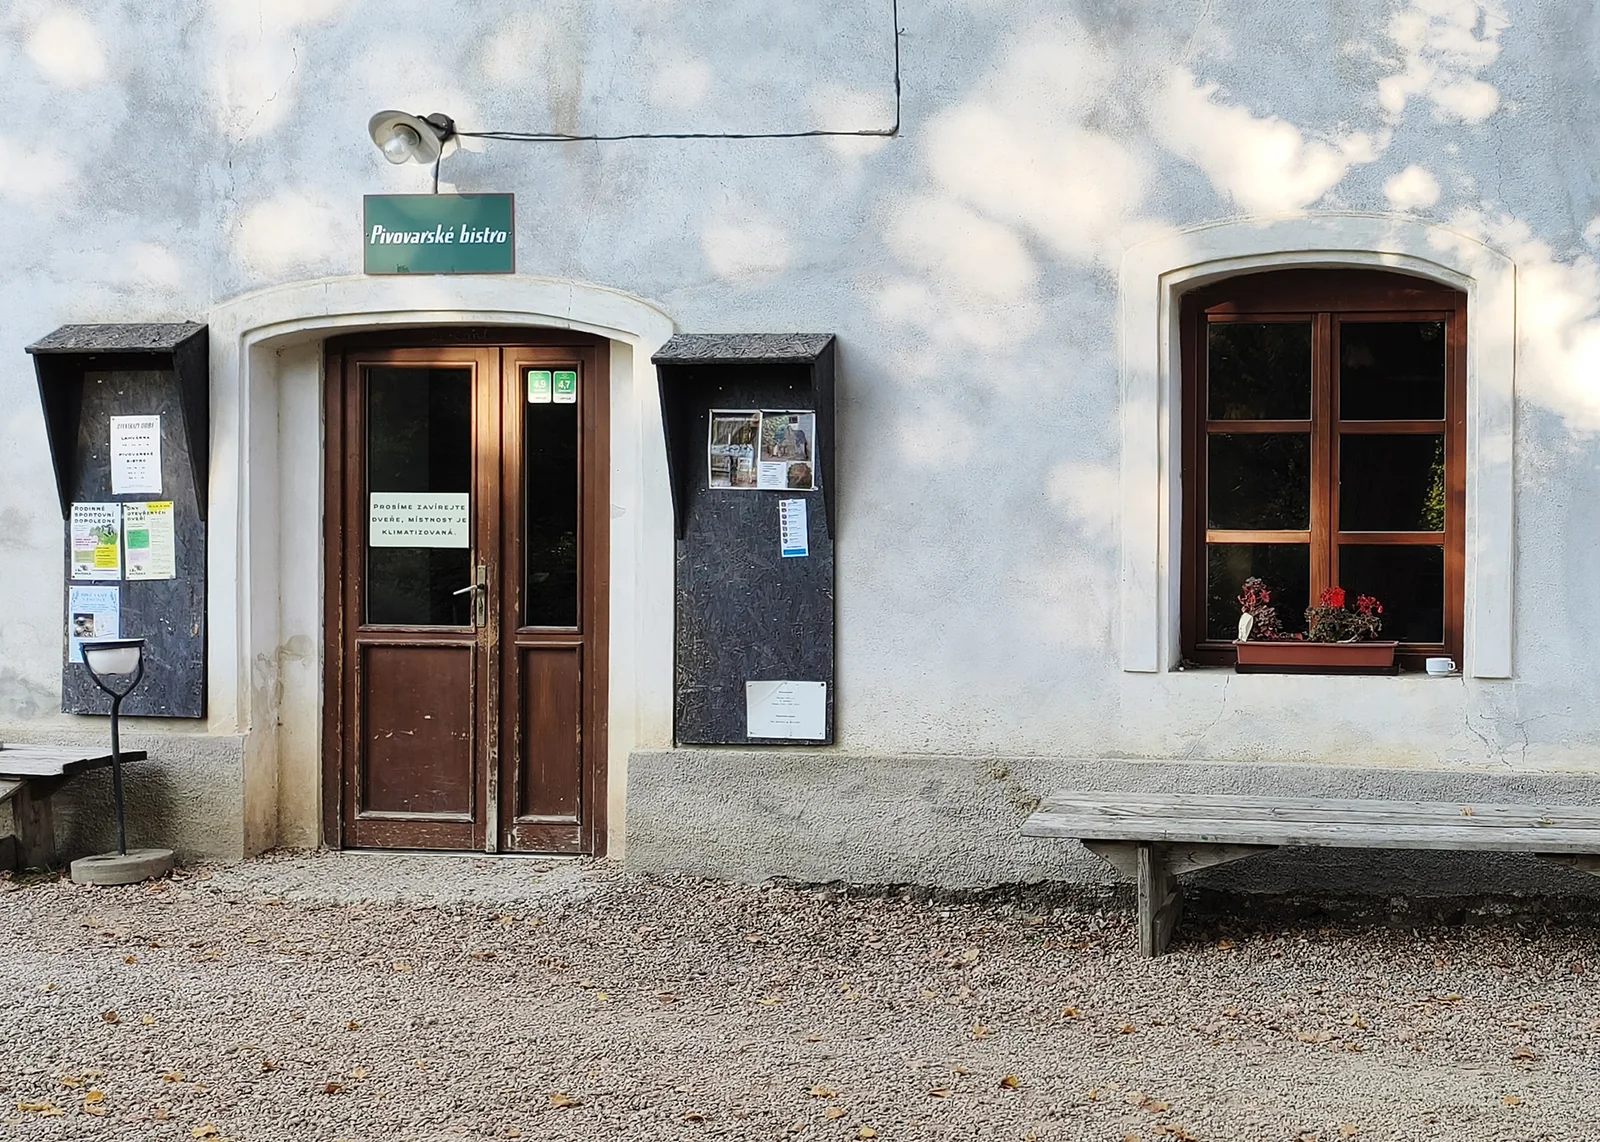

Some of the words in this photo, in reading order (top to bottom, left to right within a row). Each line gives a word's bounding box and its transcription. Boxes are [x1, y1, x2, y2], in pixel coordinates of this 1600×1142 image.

[370, 224, 455, 244] Pivovarské
[459, 223, 507, 244] bistro
[558, 379, 571, 390] 4,7
[417, 503, 466, 511] ZAVÍREJTE
[408, 515, 453, 523] MÍSTNOST
[381, 528, 457, 536] KLIMATIZOVANÁ.
